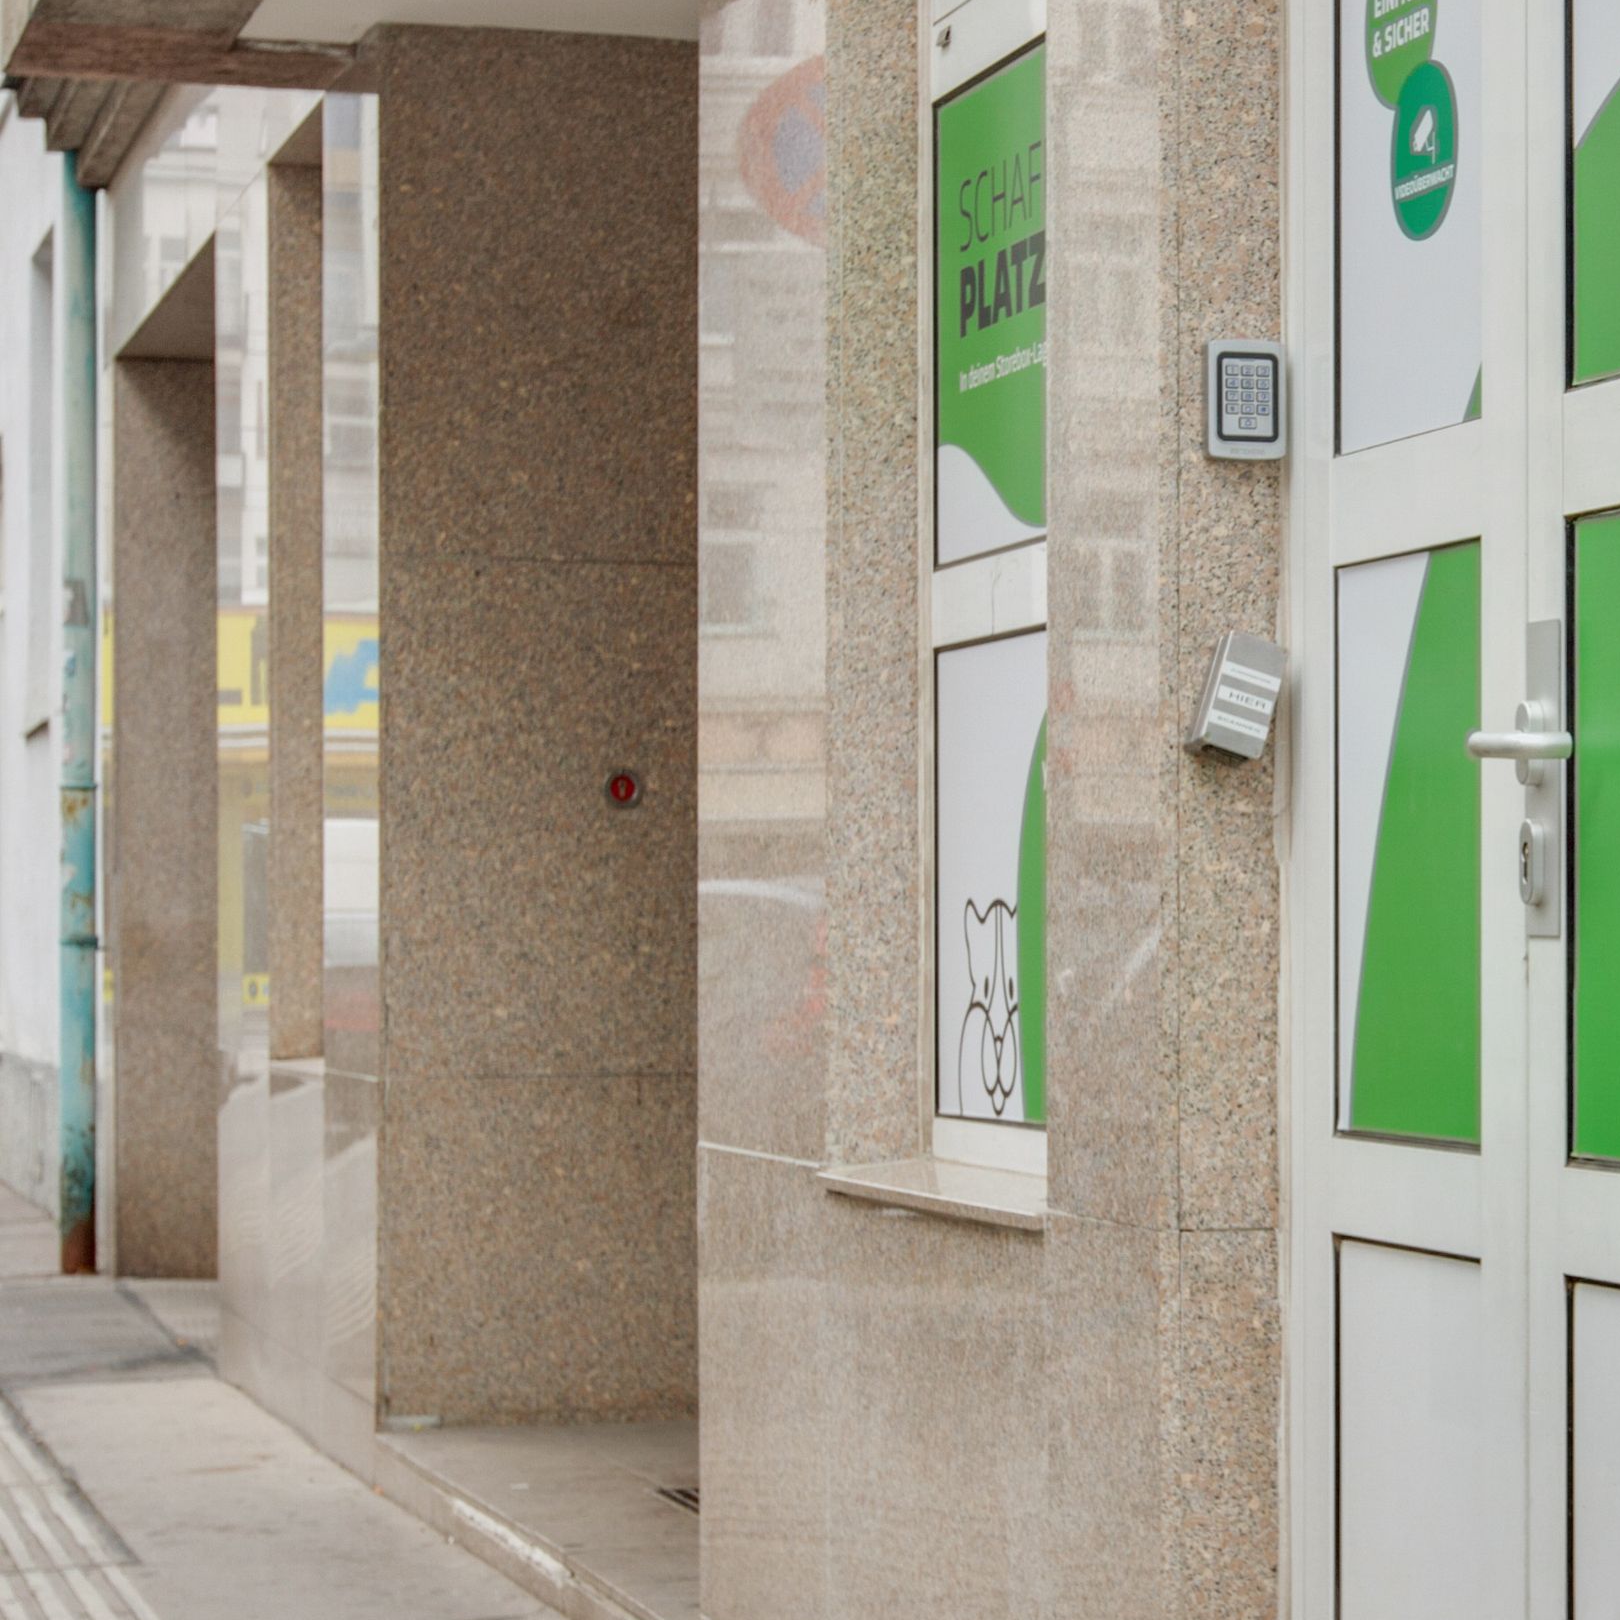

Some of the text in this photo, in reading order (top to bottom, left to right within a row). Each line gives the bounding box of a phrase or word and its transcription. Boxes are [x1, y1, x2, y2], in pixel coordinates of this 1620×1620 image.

[1371, 7, 1430, 58] & SICHER
[959, 229, 1046, 339] PLATZ
